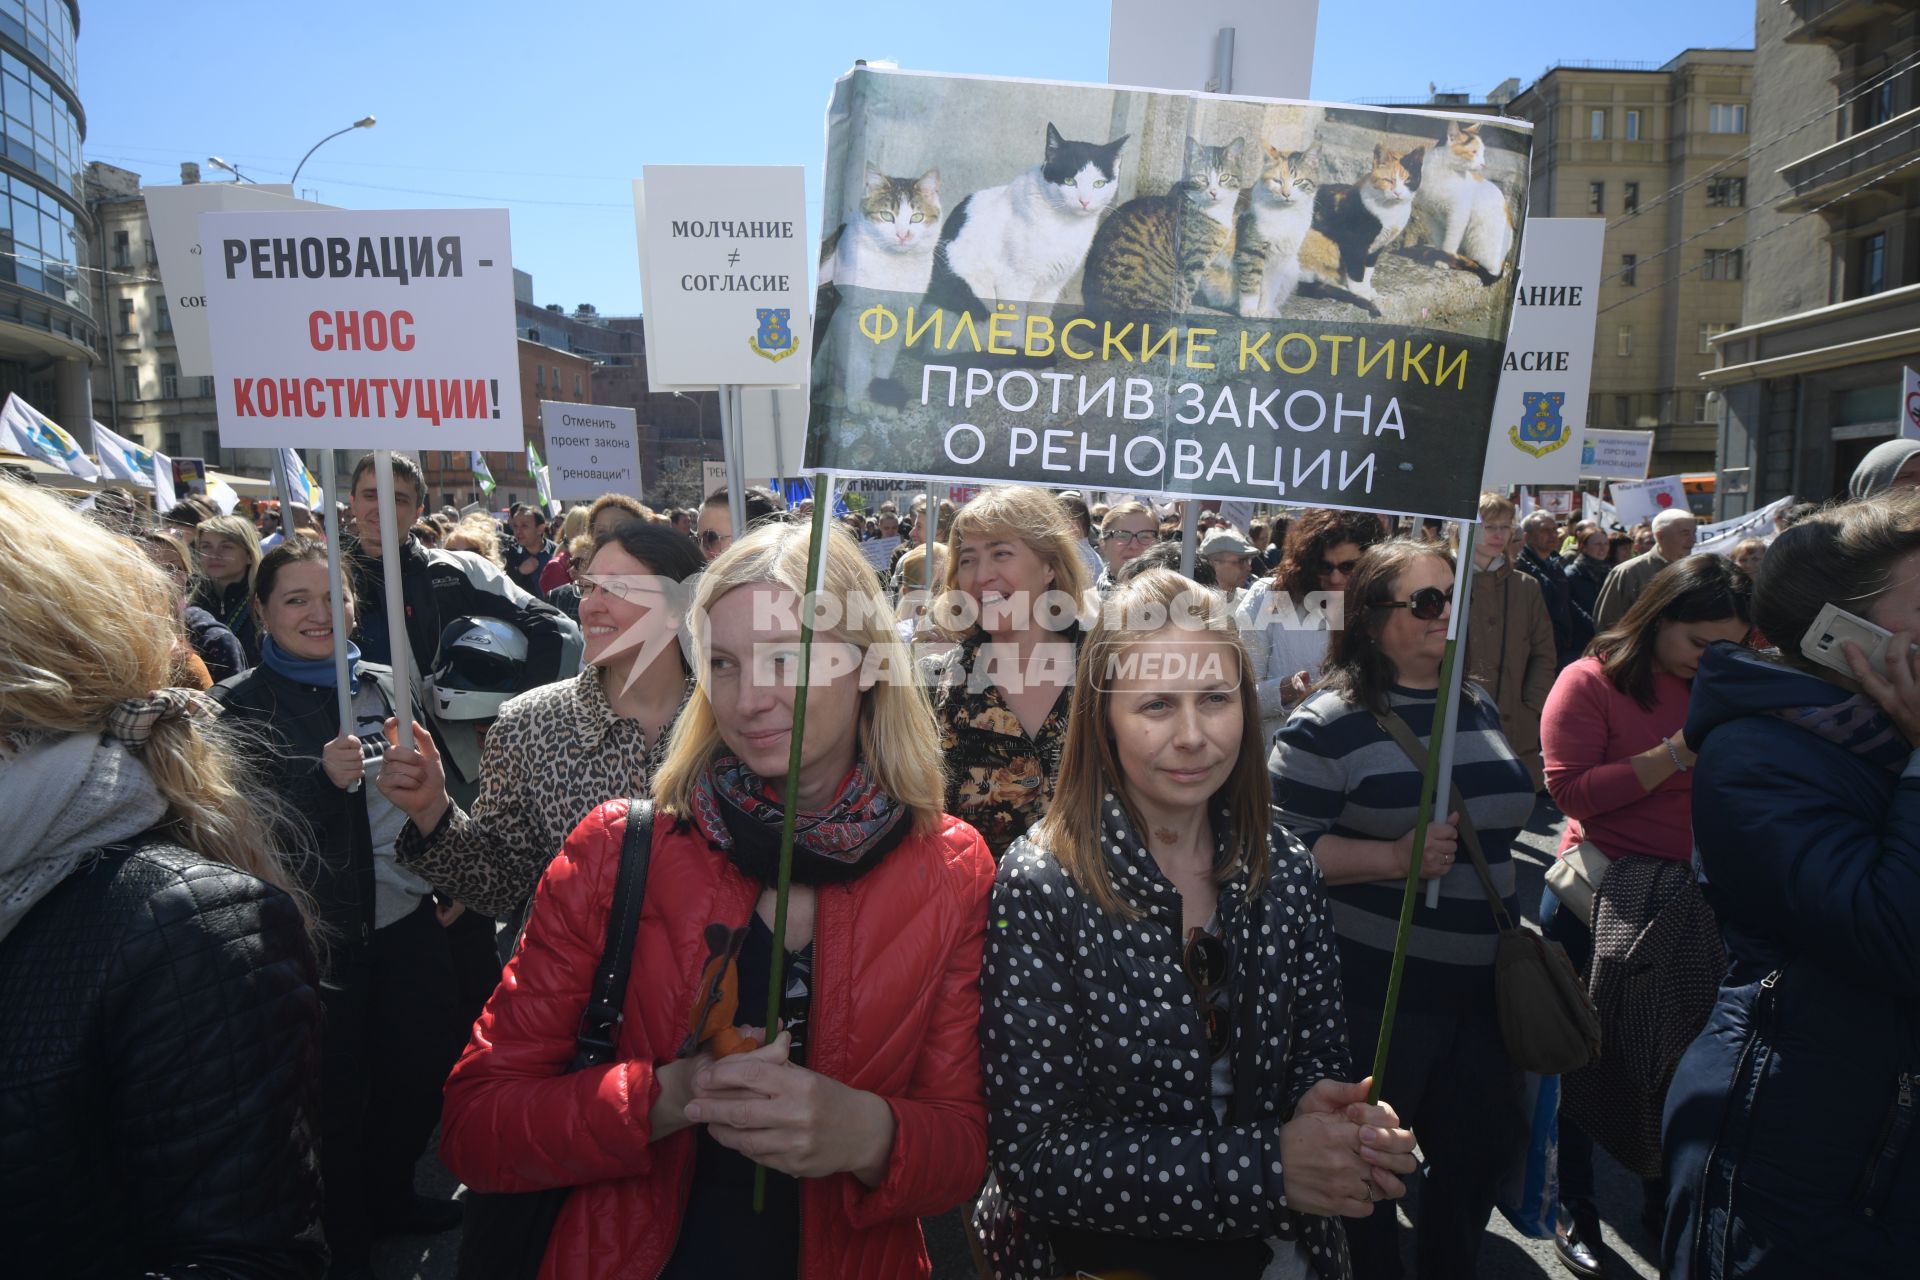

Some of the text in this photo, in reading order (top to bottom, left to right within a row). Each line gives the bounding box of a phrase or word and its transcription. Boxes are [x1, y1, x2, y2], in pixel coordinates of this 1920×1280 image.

[671, 220, 793, 238] МОЛЧАНИЕ
[223, 235, 463, 285] РЕНОВАЦИЯ
[681, 274, 790, 291] СОГЛАСИЕ
[308, 310, 416, 352] СНОС
[859, 303, 1468, 390] ФИЛЁВСКИЕ КОТИКИ
[1503, 351, 1570, 371] АСИЕ
[233, 377, 501, 426] КОНСТИТУЦИИ!
[921, 364, 1406, 439] ПРОТИВ ЗАКОНА
[562, 414, 616, 430] Отменить
[551, 436, 630, 449] проект закона
[590, 455, 598, 464] о
[944, 423, 1376, 496] О РЕНОВАЦИИ
